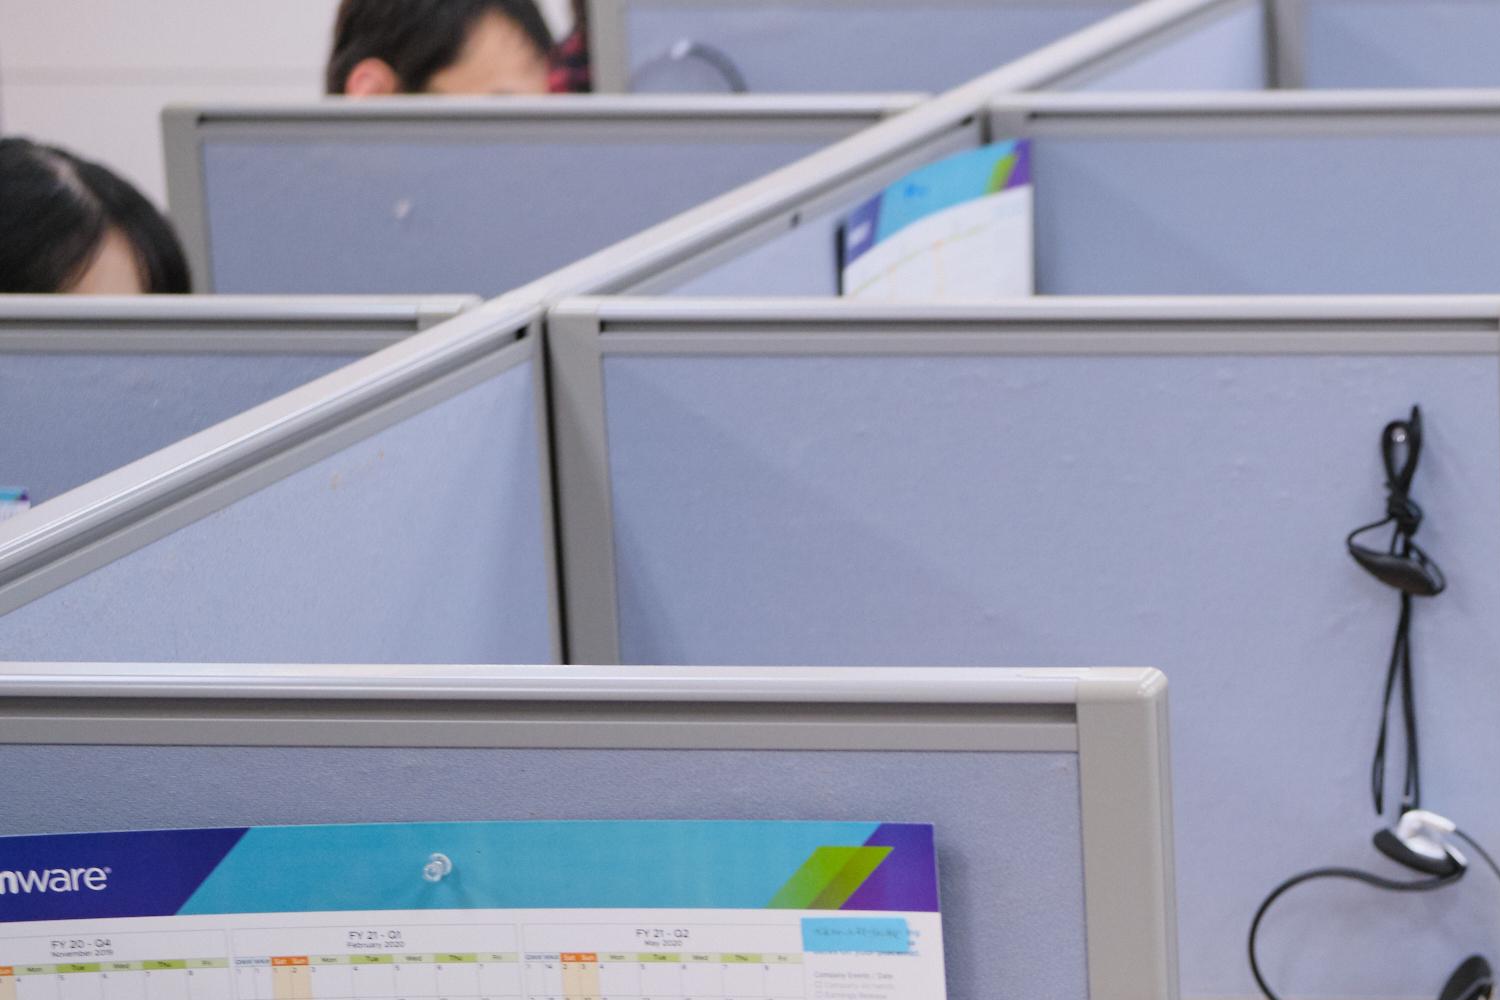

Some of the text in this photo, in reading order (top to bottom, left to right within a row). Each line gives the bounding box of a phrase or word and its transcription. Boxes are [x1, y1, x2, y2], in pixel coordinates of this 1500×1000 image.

[349, 931, 363, 939] FY
[635, 930, 650, 938] FY
[654, 929, 665, 938] 21
[674, 929, 689, 938] Q2
[51, 941, 66, 949] FY
[69, 940, 84, 948] 20
[95, 939, 112, 948] Q4
[347, 941, 382, 949] February
[662, 939, 682, 947] 2020
